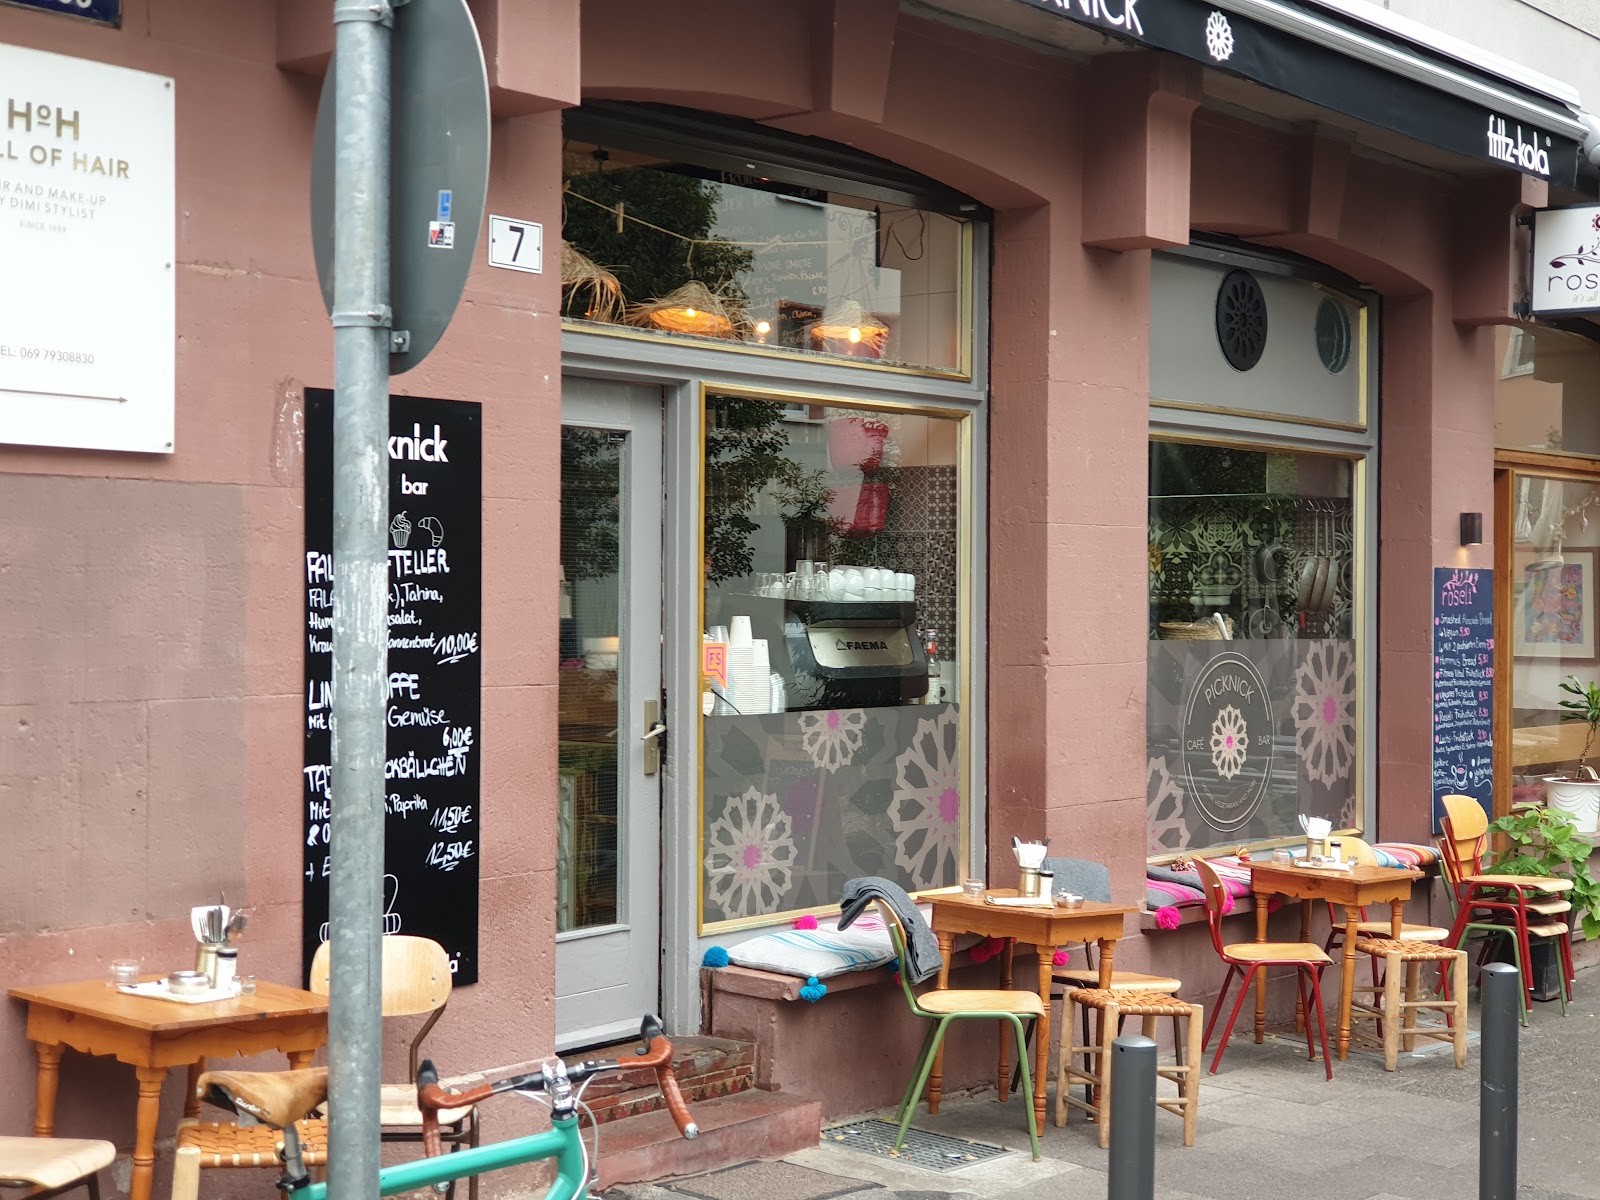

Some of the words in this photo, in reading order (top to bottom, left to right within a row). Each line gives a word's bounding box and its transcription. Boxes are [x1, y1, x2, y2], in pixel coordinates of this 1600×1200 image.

[29, 144, 63, 167] OF
[72, 151, 130, 179] HAIR
[14, 182, 44, 197] AND
[10, 197, 41, 212] DIMI
[45, 202, 96, 220] STYLIST
[19, 219, 46, 231] SINCE
[49, 222, 68, 233] 1999
[509, 225, 525, 262] 7
[1547, 273, 1600, 293] ros
[20, 347, 40, 359] 069
[44, 349, 95, 365] 79308830
[387, 422, 450, 463] knick
[401, 473, 429, 496] bar
[306, 551, 335, 584] FAL
[1442, 584, 1473, 607] roseli
[846, 640, 889, 652] FAEMA
[308, 679, 333, 711] LIN
[1204, 674, 1255, 705] PICKNICK
[308, 714, 328, 731] Mit
[387, 705, 451, 728] Gemüse
[1186, 736, 1205, 751] CAFÉ
[1258, 735, 1271, 746] BAR
[309, 801, 332, 821] Mit
